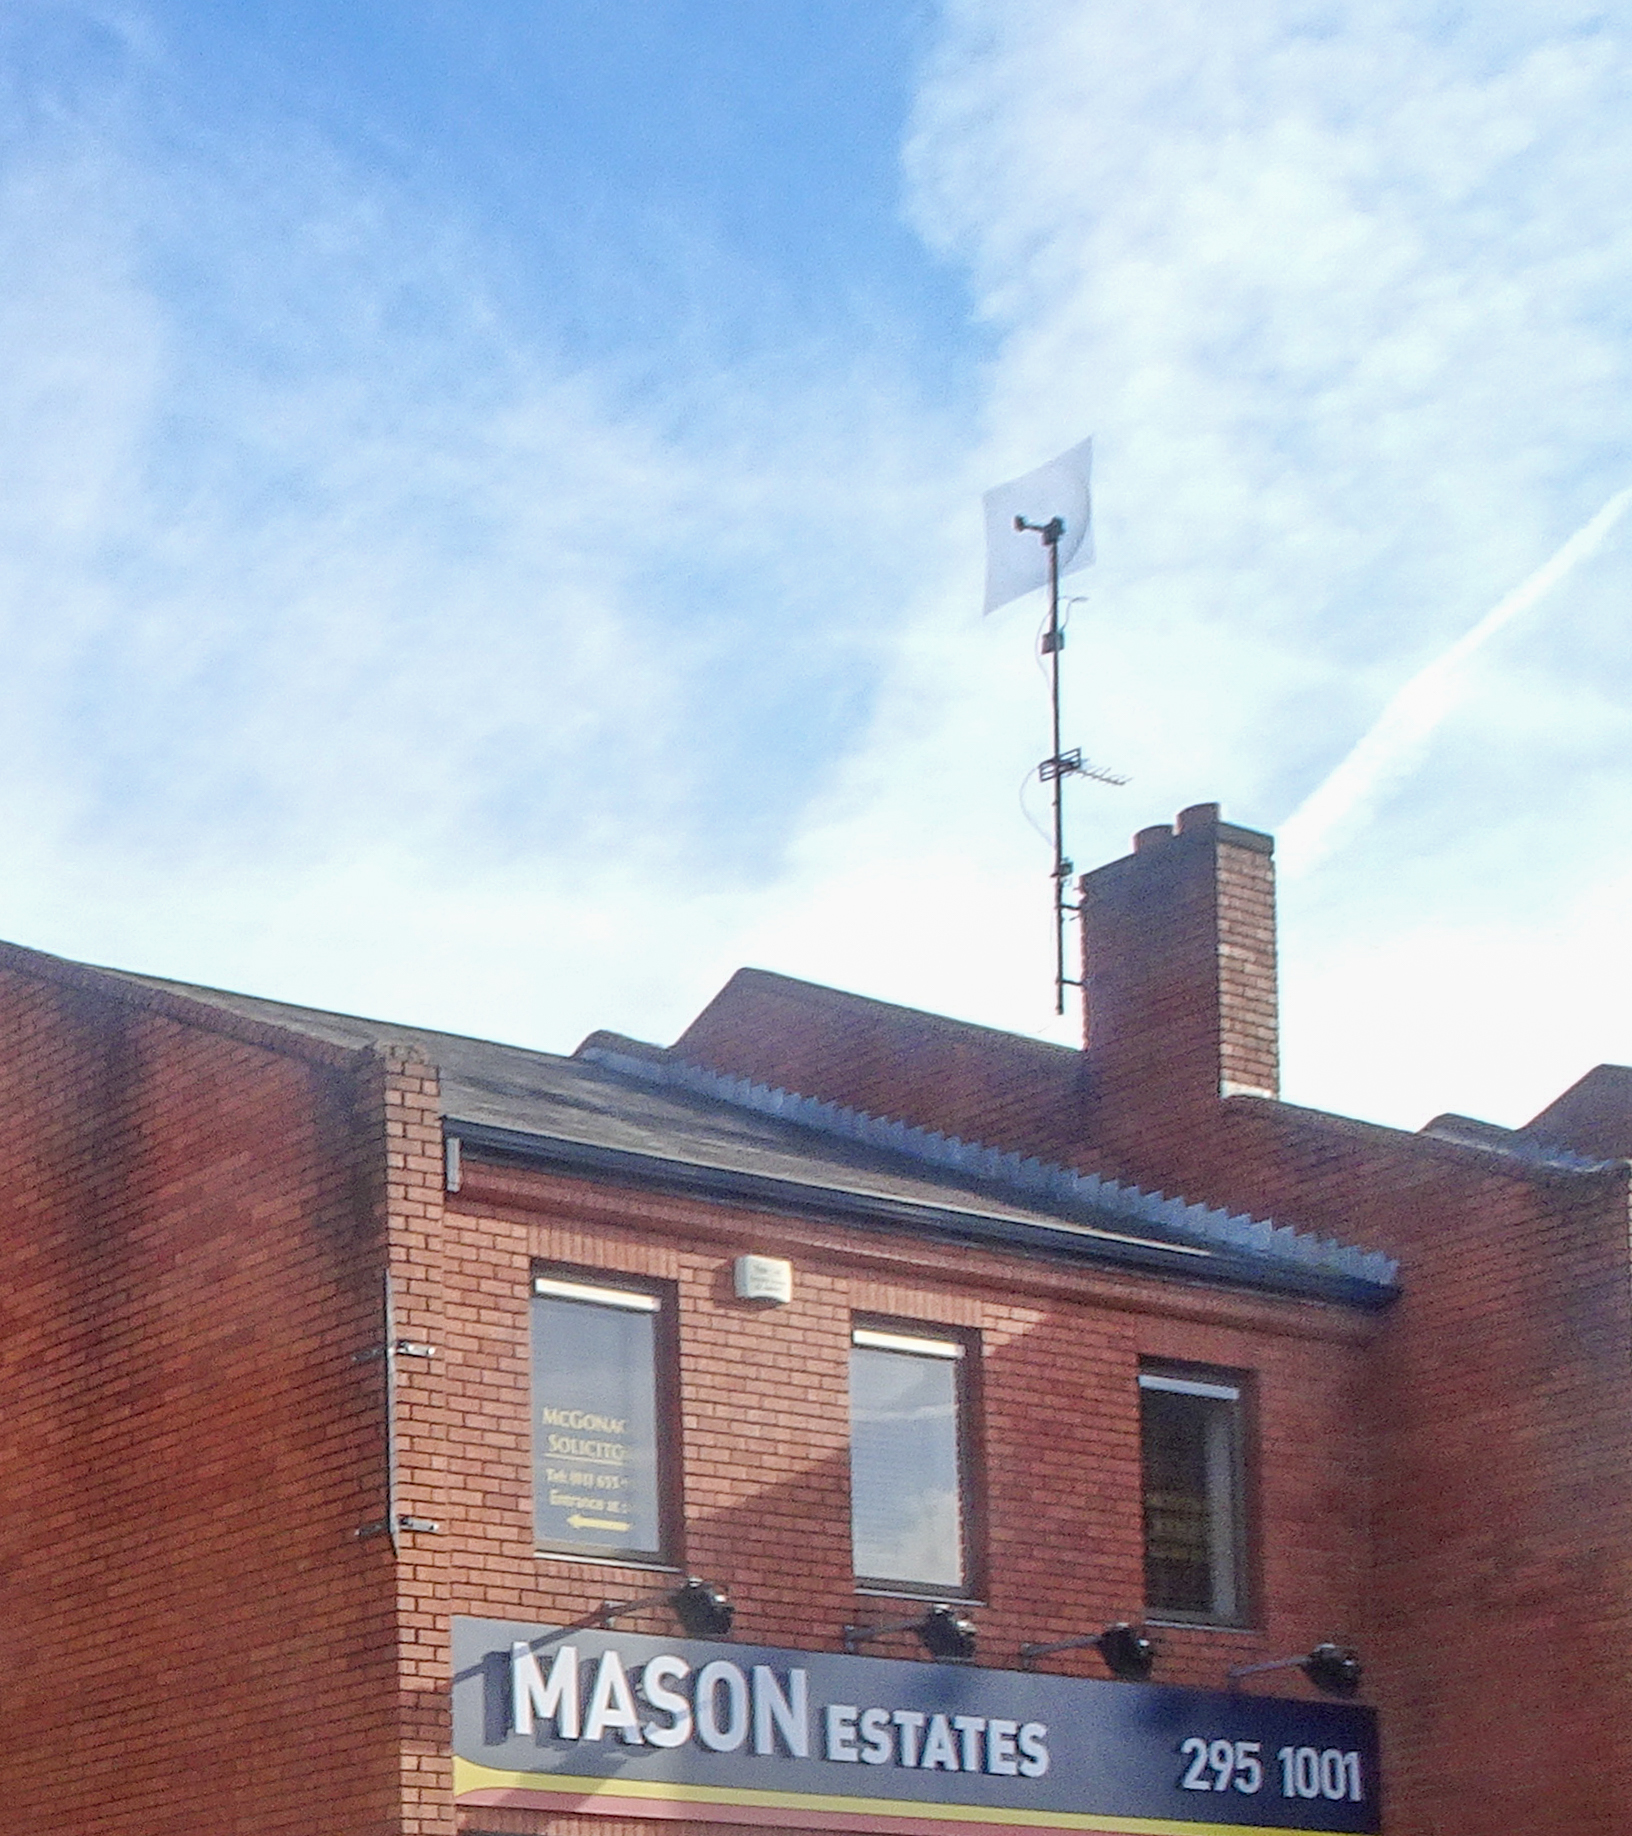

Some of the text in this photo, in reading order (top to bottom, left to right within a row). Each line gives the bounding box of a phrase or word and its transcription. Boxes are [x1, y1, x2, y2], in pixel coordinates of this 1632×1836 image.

[512, 1640, 1362, 1802] MASON ESTATES 295 1001
